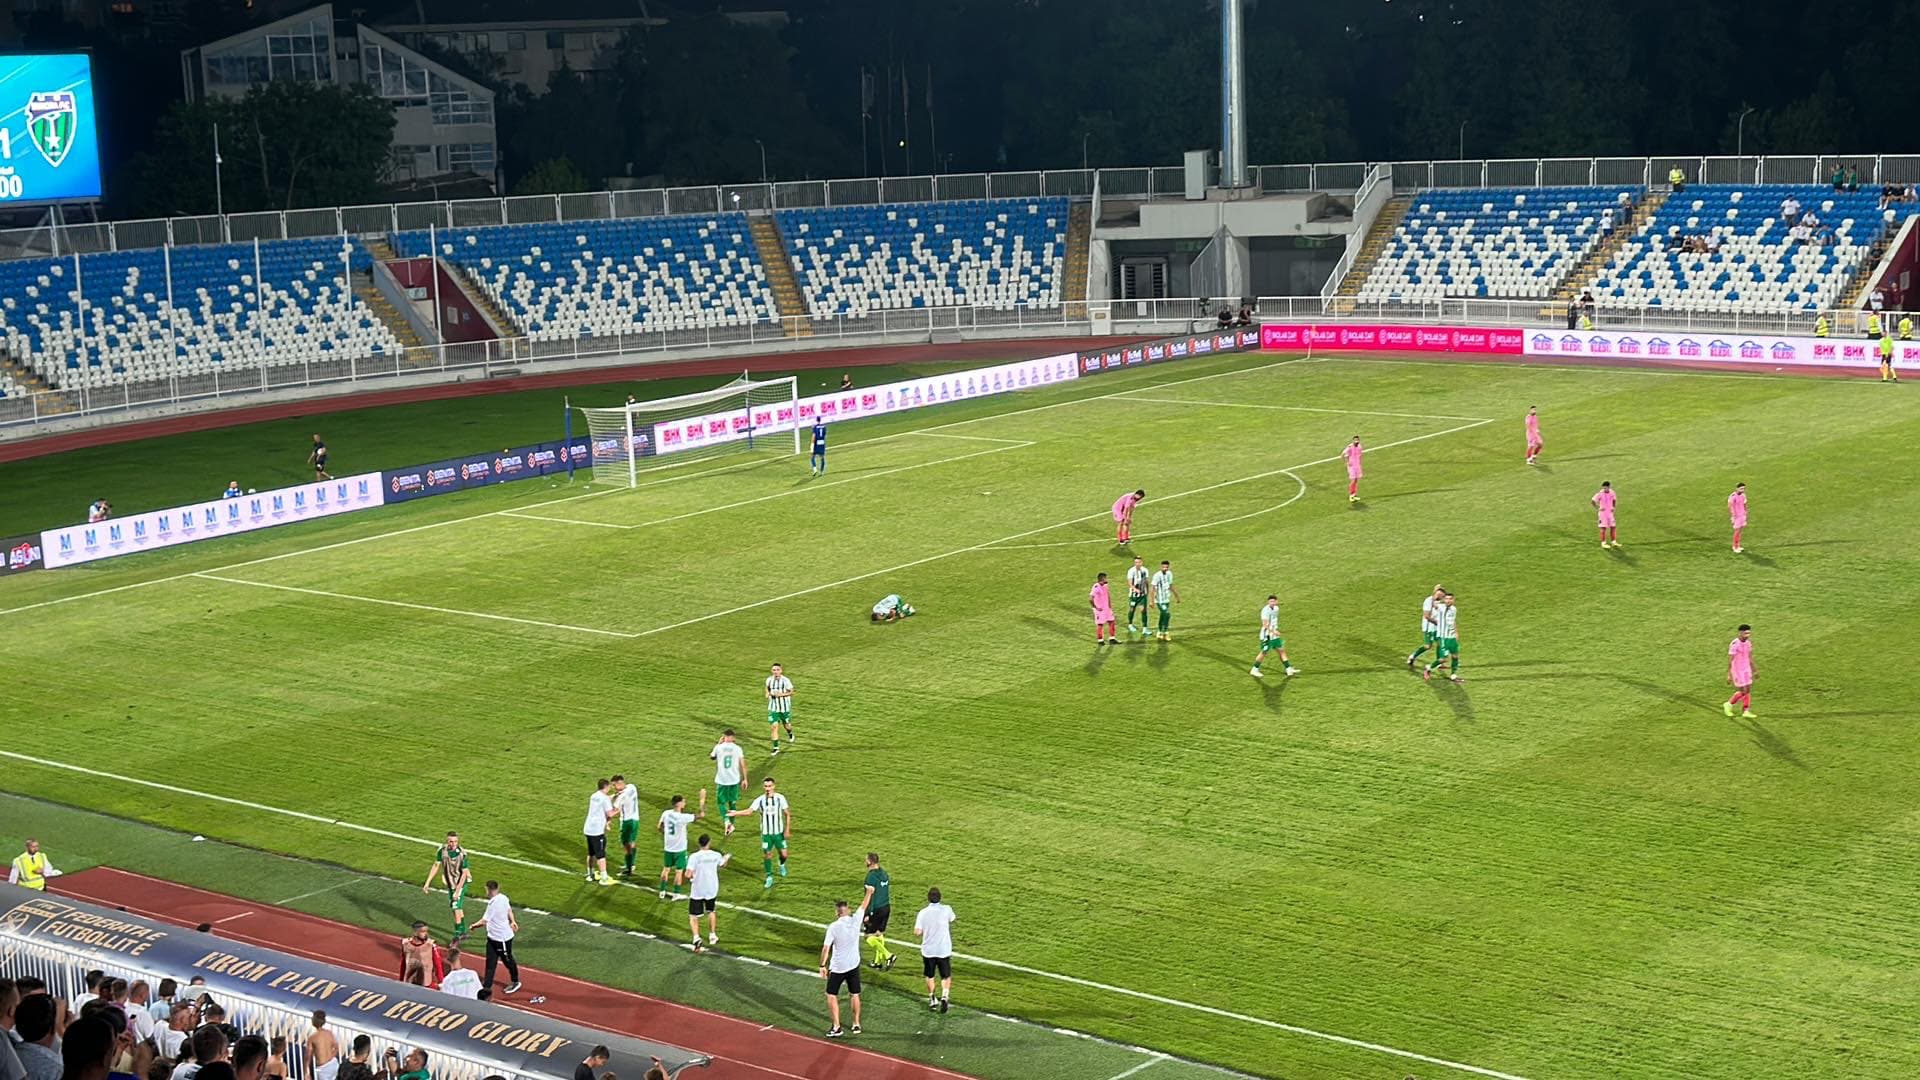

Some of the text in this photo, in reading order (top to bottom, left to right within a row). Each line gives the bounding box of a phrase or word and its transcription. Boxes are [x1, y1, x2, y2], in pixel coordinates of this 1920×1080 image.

[723, 755, 732, 769] 6
[668, 821, 675, 835] 3
[42, 921, 139, 952] FUTBOLLIT
[130, 942, 152, 956] E
[64, 911, 168, 941] FEDERATA E
[192, 951, 573, 1057] FROM PAIN TO EURO GLORY
